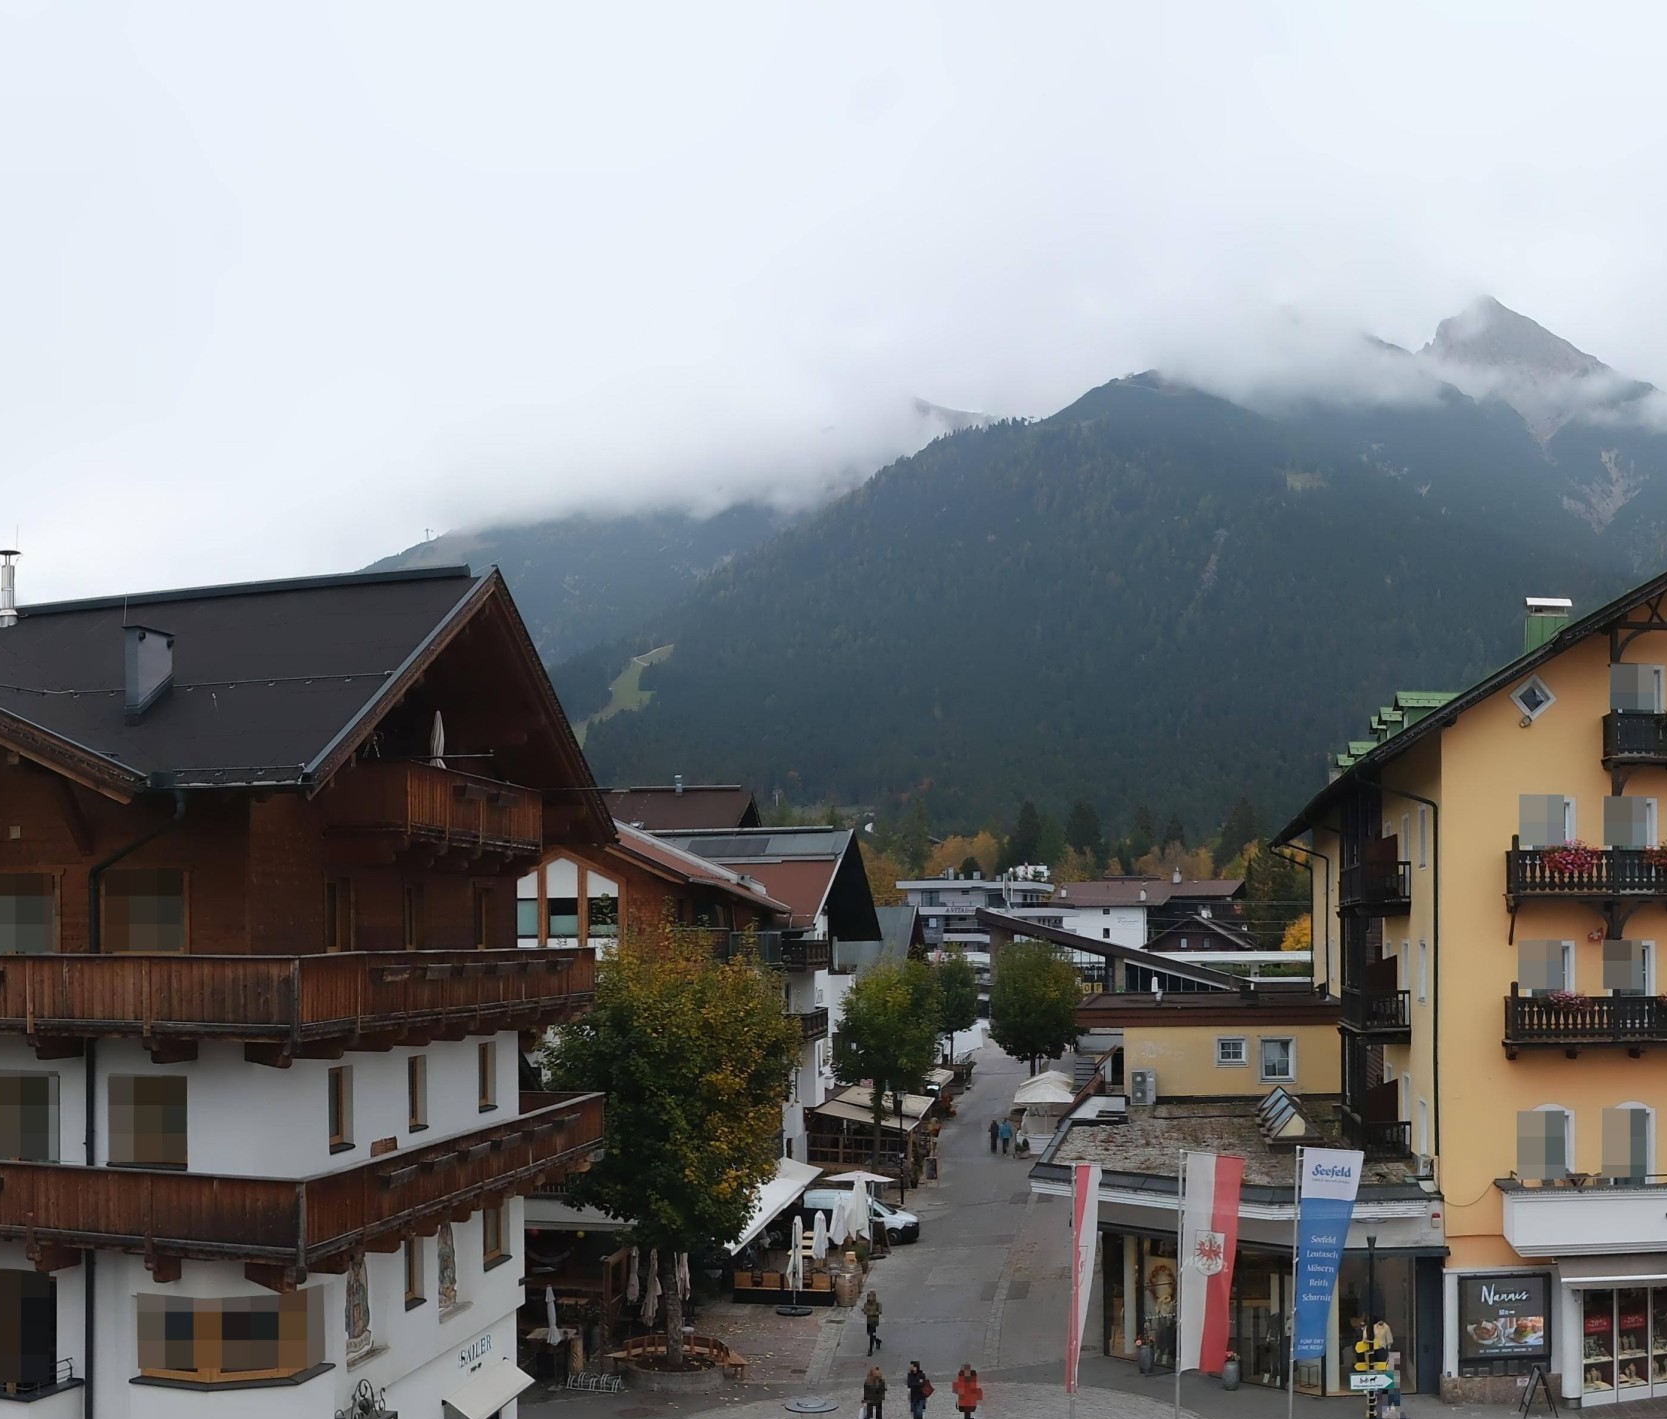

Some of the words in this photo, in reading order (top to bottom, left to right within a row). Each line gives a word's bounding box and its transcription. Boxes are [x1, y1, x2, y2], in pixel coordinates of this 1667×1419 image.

[1312, 1164, 1352, 1178] Seefeld
[1311, 1235, 1336, 1244] Seefeld
[1307, 1250, 1338, 1259] Leutasch
[1307, 1264, 1334, 1273] Mösern
[1309, 1279, 1328, 1287] Reith
